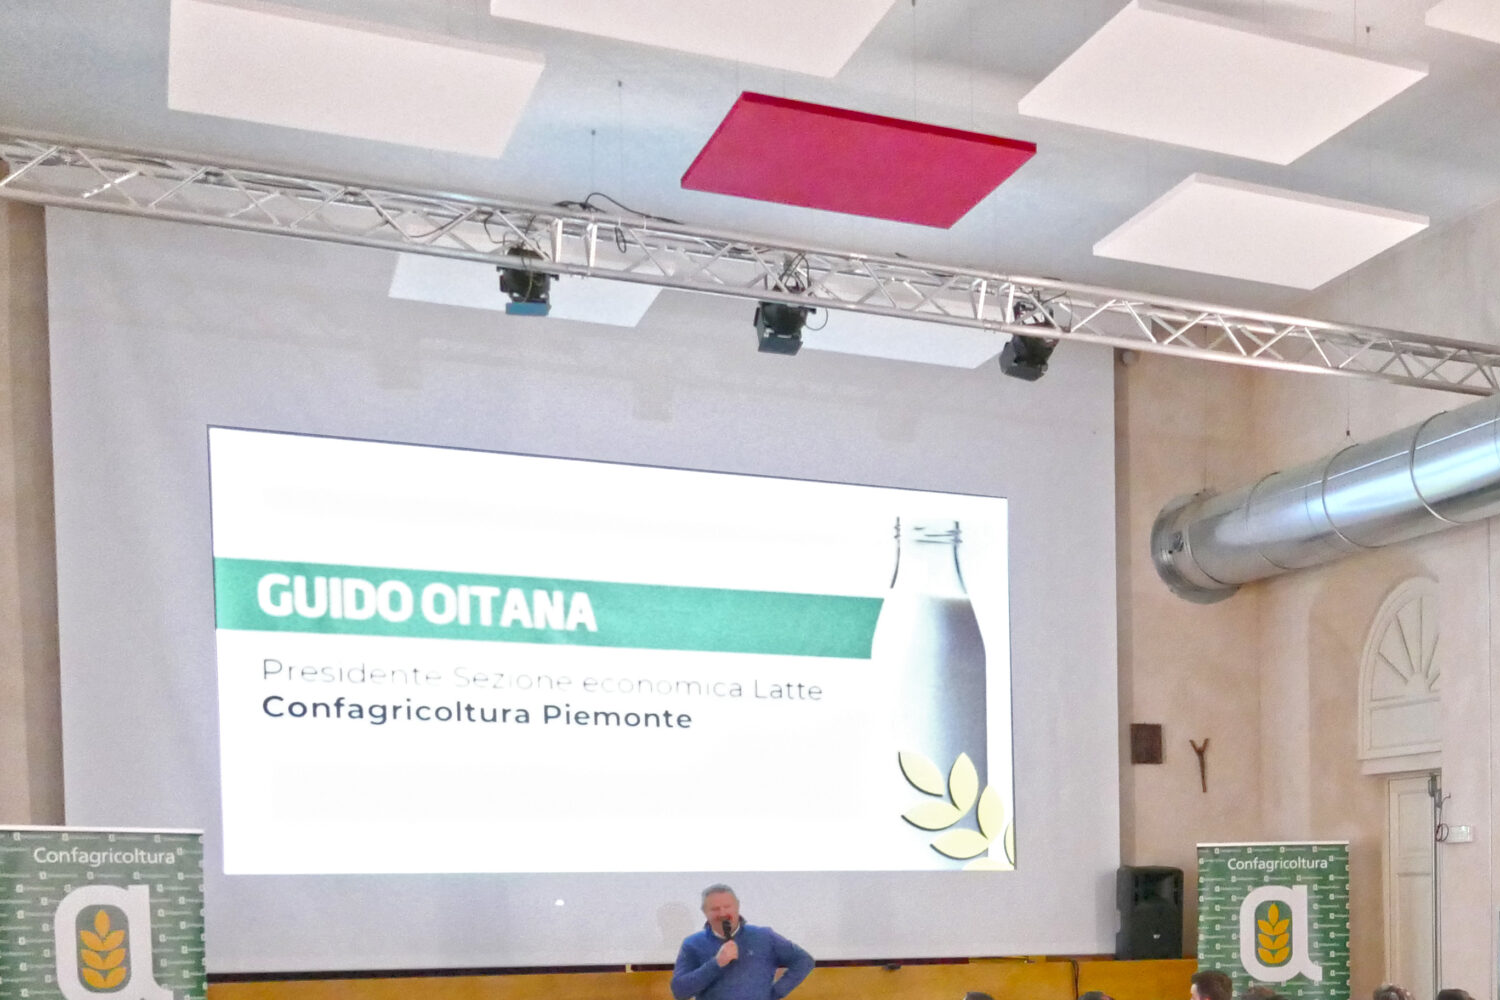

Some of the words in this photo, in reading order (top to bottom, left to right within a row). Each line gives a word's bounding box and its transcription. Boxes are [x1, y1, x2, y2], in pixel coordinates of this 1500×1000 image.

[257, 573, 414, 623] GUIDO
[421, 582, 598, 632] OITANA
[263, 658, 442, 686] Presidente
[454, 666, 572, 692] Sezione
[583, 677, 743, 698] economica
[754, 679, 823, 701] Latte
[262, 695, 530, 725] Confagricoltura
[543, 703, 692, 728] Piemonte
[34, 847, 176, 867] Confagricoltura
[1227, 857, 1328, 872] Confagricoltura
